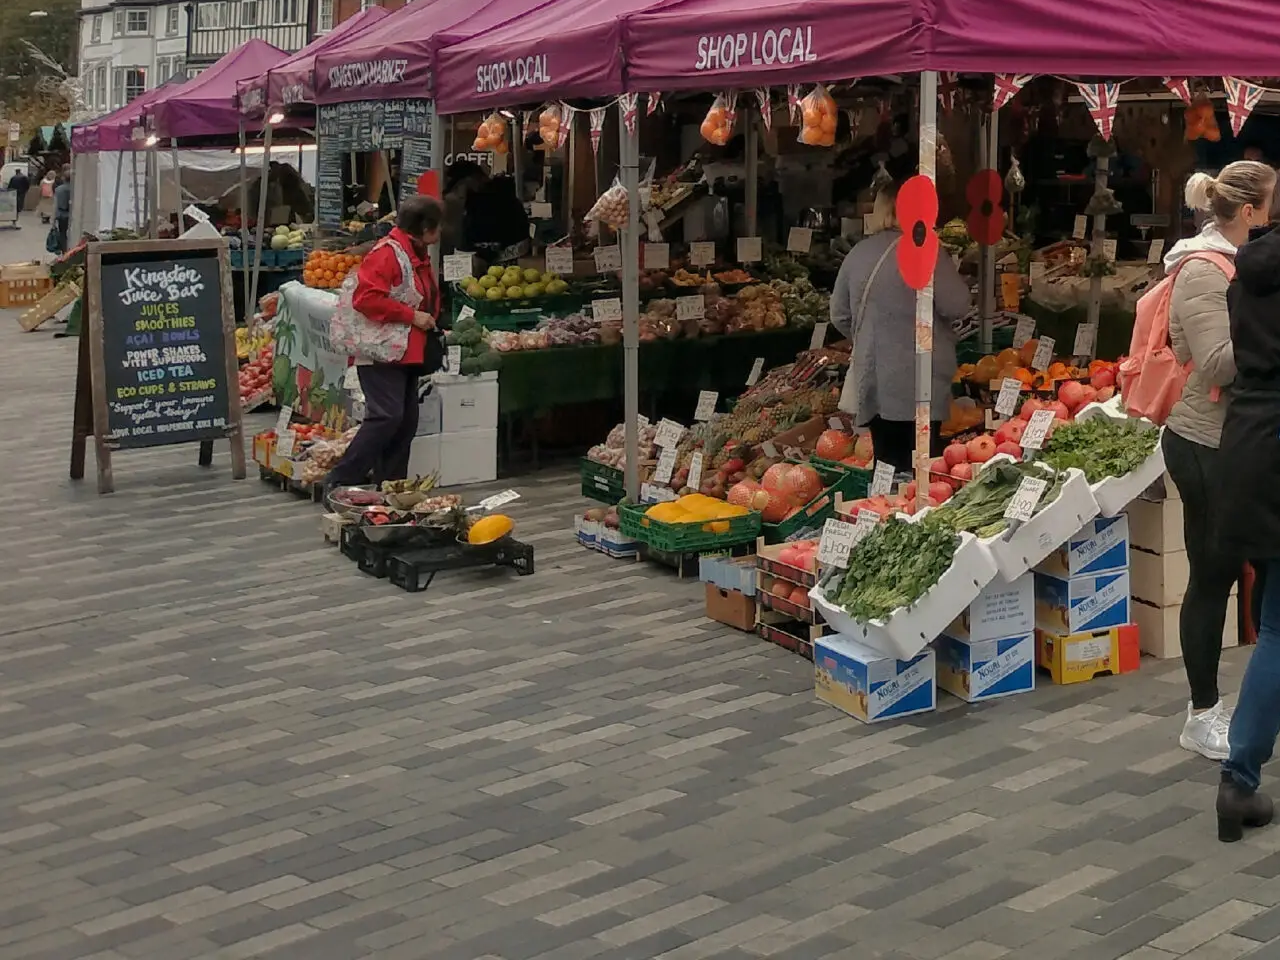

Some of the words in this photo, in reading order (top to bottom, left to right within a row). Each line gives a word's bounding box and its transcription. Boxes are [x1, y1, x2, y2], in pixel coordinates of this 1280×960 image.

[695, 33, 748, 70] SHOP
[751, 25, 818, 66] LOCAL
[328, 62, 368, 89] KINGSTON
[368, 58, 408, 86] MARKET
[476, 63, 508, 93] SHOP
[509, 54, 551, 88] LOCAL
[124, 264, 202, 290] Kingston
[118, 289, 162, 306] Juice
[168, 283, 205, 301] Bar
[140, 303, 180, 316] JUICES
[135, 316, 196, 331] SMOOTHIES
[122, 359, 148, 368] WITH
[152, 353, 207, 366] SUPERFOODS
[127, 348, 159, 360] POWER
[162, 344, 201, 357] SHAKES
[137, 368, 166, 382] ICED
[168, 365, 194, 378] TEA
[116, 387, 137, 398] ECO
[138, 384, 165, 395] CUPS
[168, 382, 177, 393] &
[179, 378, 217, 391] STRAWS
[155, 400, 179, 413] your
[132, 425, 155, 436] LOCAL
